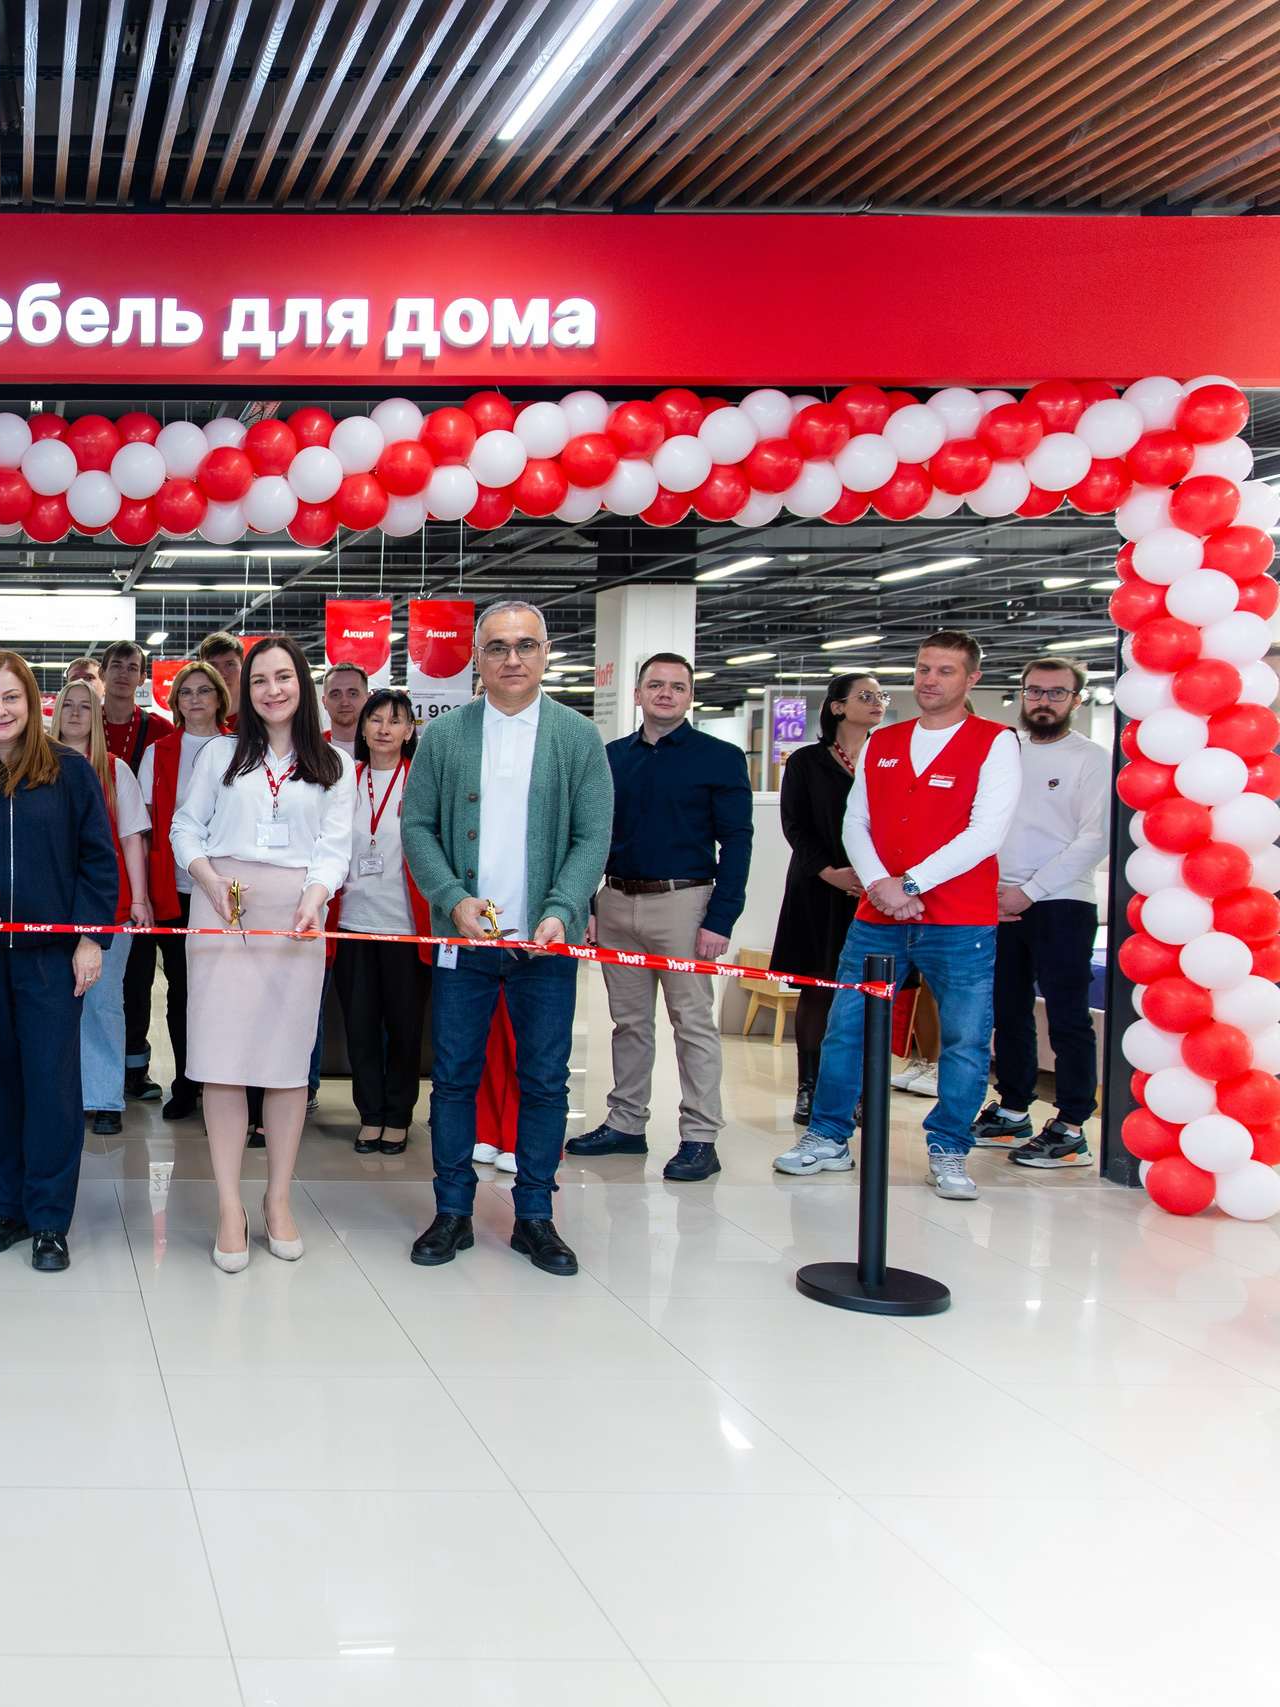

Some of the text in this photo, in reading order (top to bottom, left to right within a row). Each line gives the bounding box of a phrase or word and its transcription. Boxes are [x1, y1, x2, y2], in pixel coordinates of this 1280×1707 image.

[222, 298, 370, 359] для
[384, 297, 597, 359] дома
[343, 629, 374, 639] Акция
[426, 629, 458, 639] Акция
[428, 704, 460, 718] 99
[877, 758, 900, 768] Hoff
[24, 924, 53, 932] Hoff
